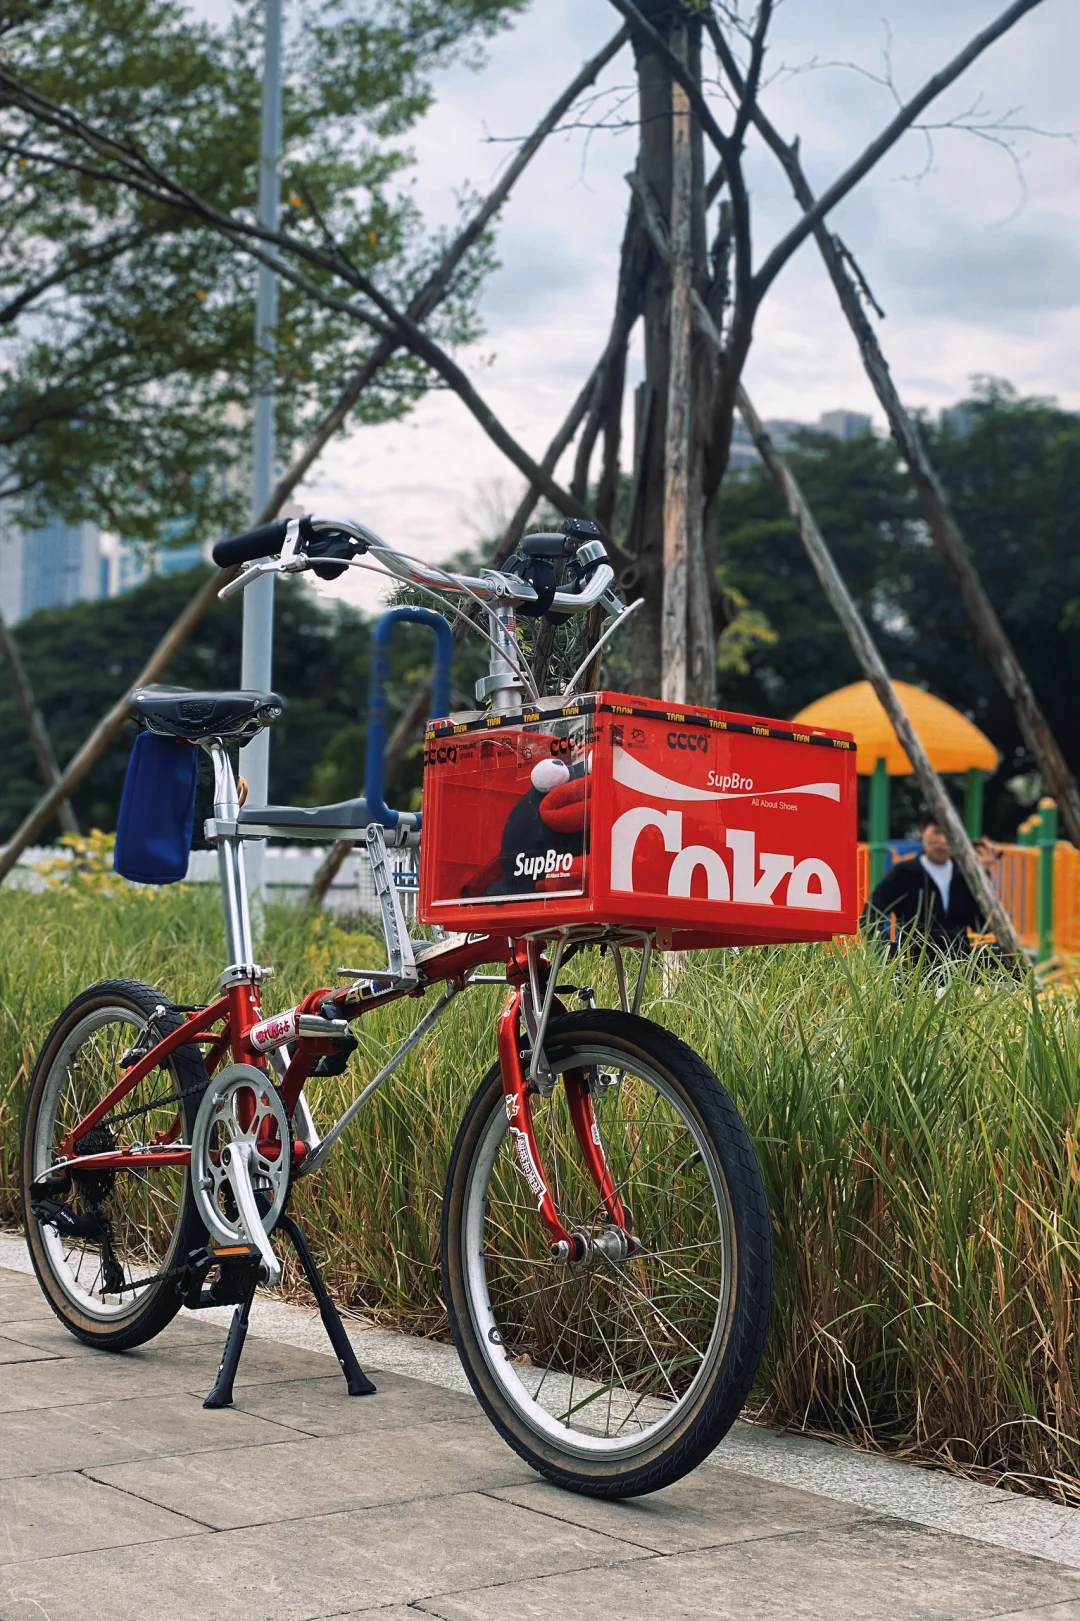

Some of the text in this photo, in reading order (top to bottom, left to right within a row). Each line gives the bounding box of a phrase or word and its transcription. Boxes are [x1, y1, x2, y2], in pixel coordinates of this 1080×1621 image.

[182, 702, 213, 713] BROOKS
[486, 716, 501, 727] TAAN
[523, 713, 540, 723] TAAN
[562, 706, 580, 716] TAAN
[611, 705, 633, 715] TAAN
[666, 712, 685, 723] TAAN
[709, 719, 727, 730] TAAN
[751, 726, 770, 736] TAAN
[793, 733, 810, 743] TAAN
[832, 739, 850, 749] TAAN
[707, 770, 754, 792] SupBro
[751, 798, 798, 812] All About Shoes
[513, 849, 574, 881] SupBro
[610, 806, 842, 912] Coke
